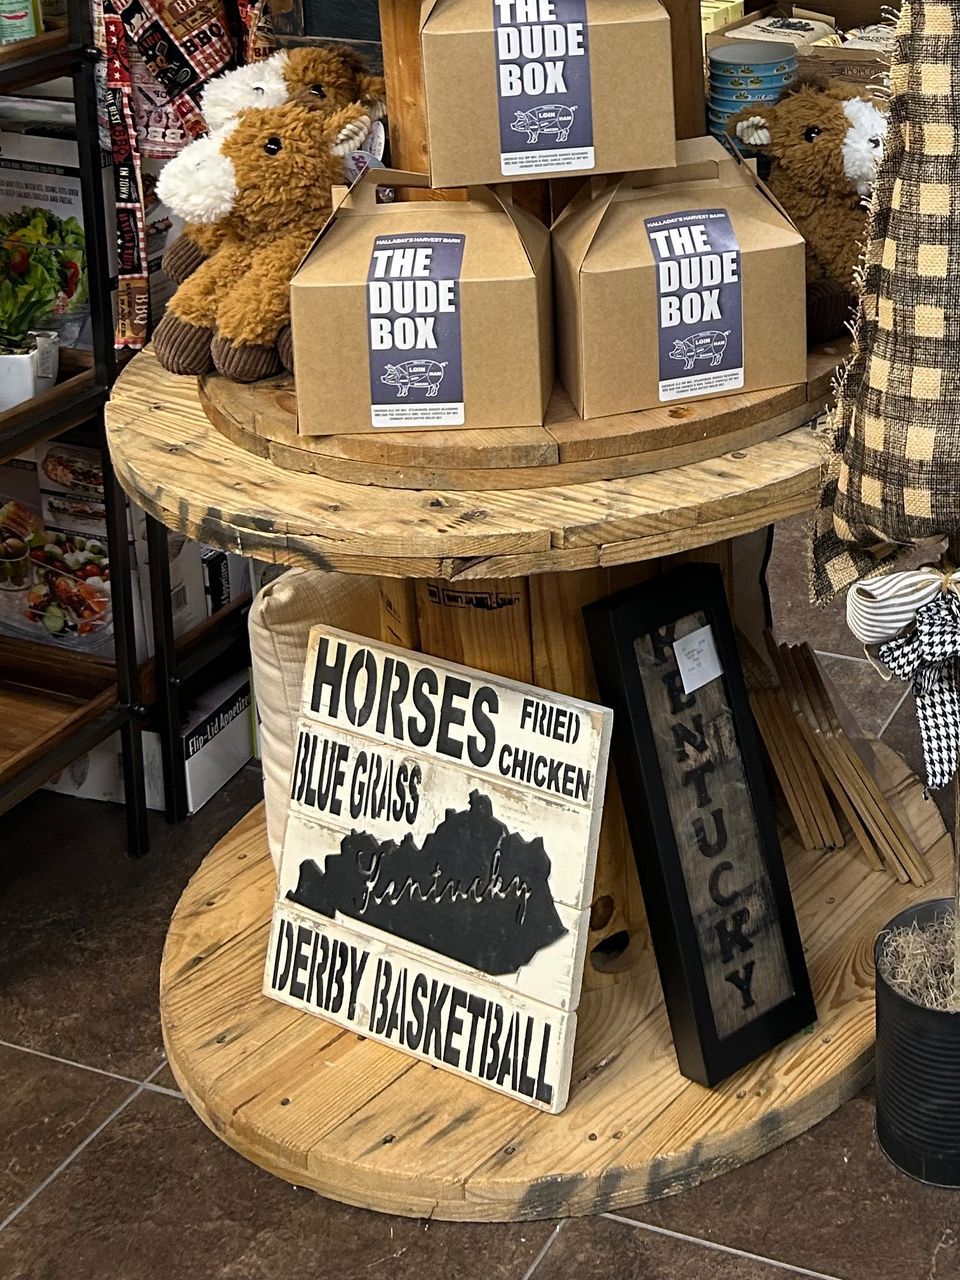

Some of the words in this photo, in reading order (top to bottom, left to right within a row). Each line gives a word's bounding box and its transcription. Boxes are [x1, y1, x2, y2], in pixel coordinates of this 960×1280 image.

[184, 23, 225, 53] BBQ
[497, 23, 585, 60] DUDE
[499, 61, 567, 97] BOX
[118, 178, 129, 200] TOWN
[647, 216, 683, 228] HALLADAY'S
[683, 214, 709, 222] HARVEST
[376, 237, 414, 245] HALLADAY'S
[650, 224, 712, 258] THE
[373, 248, 433, 278] THE
[658, 251, 739, 294] DUDE
[369, 280, 456, 314] DUDE
[660, 288, 722, 328] BOX
[370, 316, 438, 350] BOX
[695, 337, 711, 345] LOIN
[310, 635, 500, 770] HORSES
[520, 695, 581, 745] FRIED
[188, 723, 219, 756] Flip-Lid
[291, 732, 348, 816] BLUE
[349, 751, 423, 825] GRASS
[497, 747, 592, 801] CHICKEN
[650, 622, 757, 1010] KENTUCKY
[356, 847, 534, 926] Kentucky
[271, 919, 370, 1018] DERBY
[369, 959, 554, 1105] BASKETBALL
